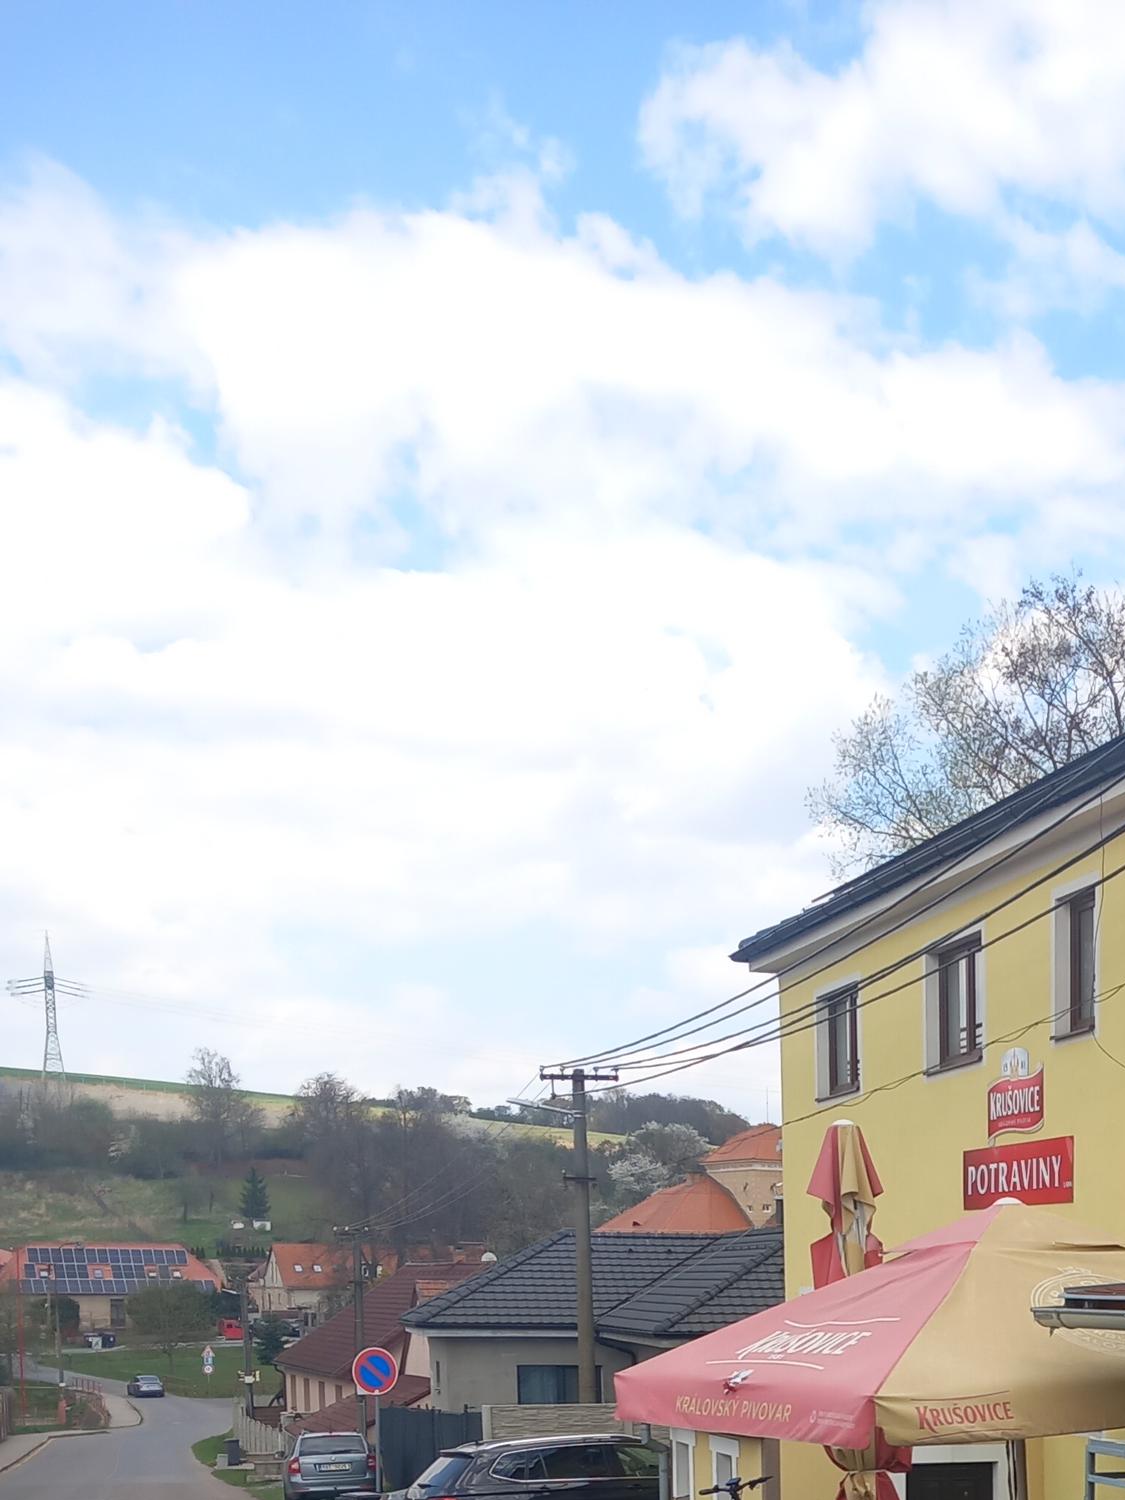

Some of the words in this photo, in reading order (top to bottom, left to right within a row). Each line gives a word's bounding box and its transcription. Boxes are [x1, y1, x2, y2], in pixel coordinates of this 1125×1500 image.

[990, 1085, 1040, 1121] KRUŠOVICE
[967, 1154, 1061, 1196] POTRAVINY
[735, 1328, 873, 1360] KRUŠOVICE
[675, 1393, 740, 1418] KRÁLOVSKÝ
[740, 1400, 792, 1423] PIVOVAR
[914, 1401, 1014, 1434] KRUŠOVICE
